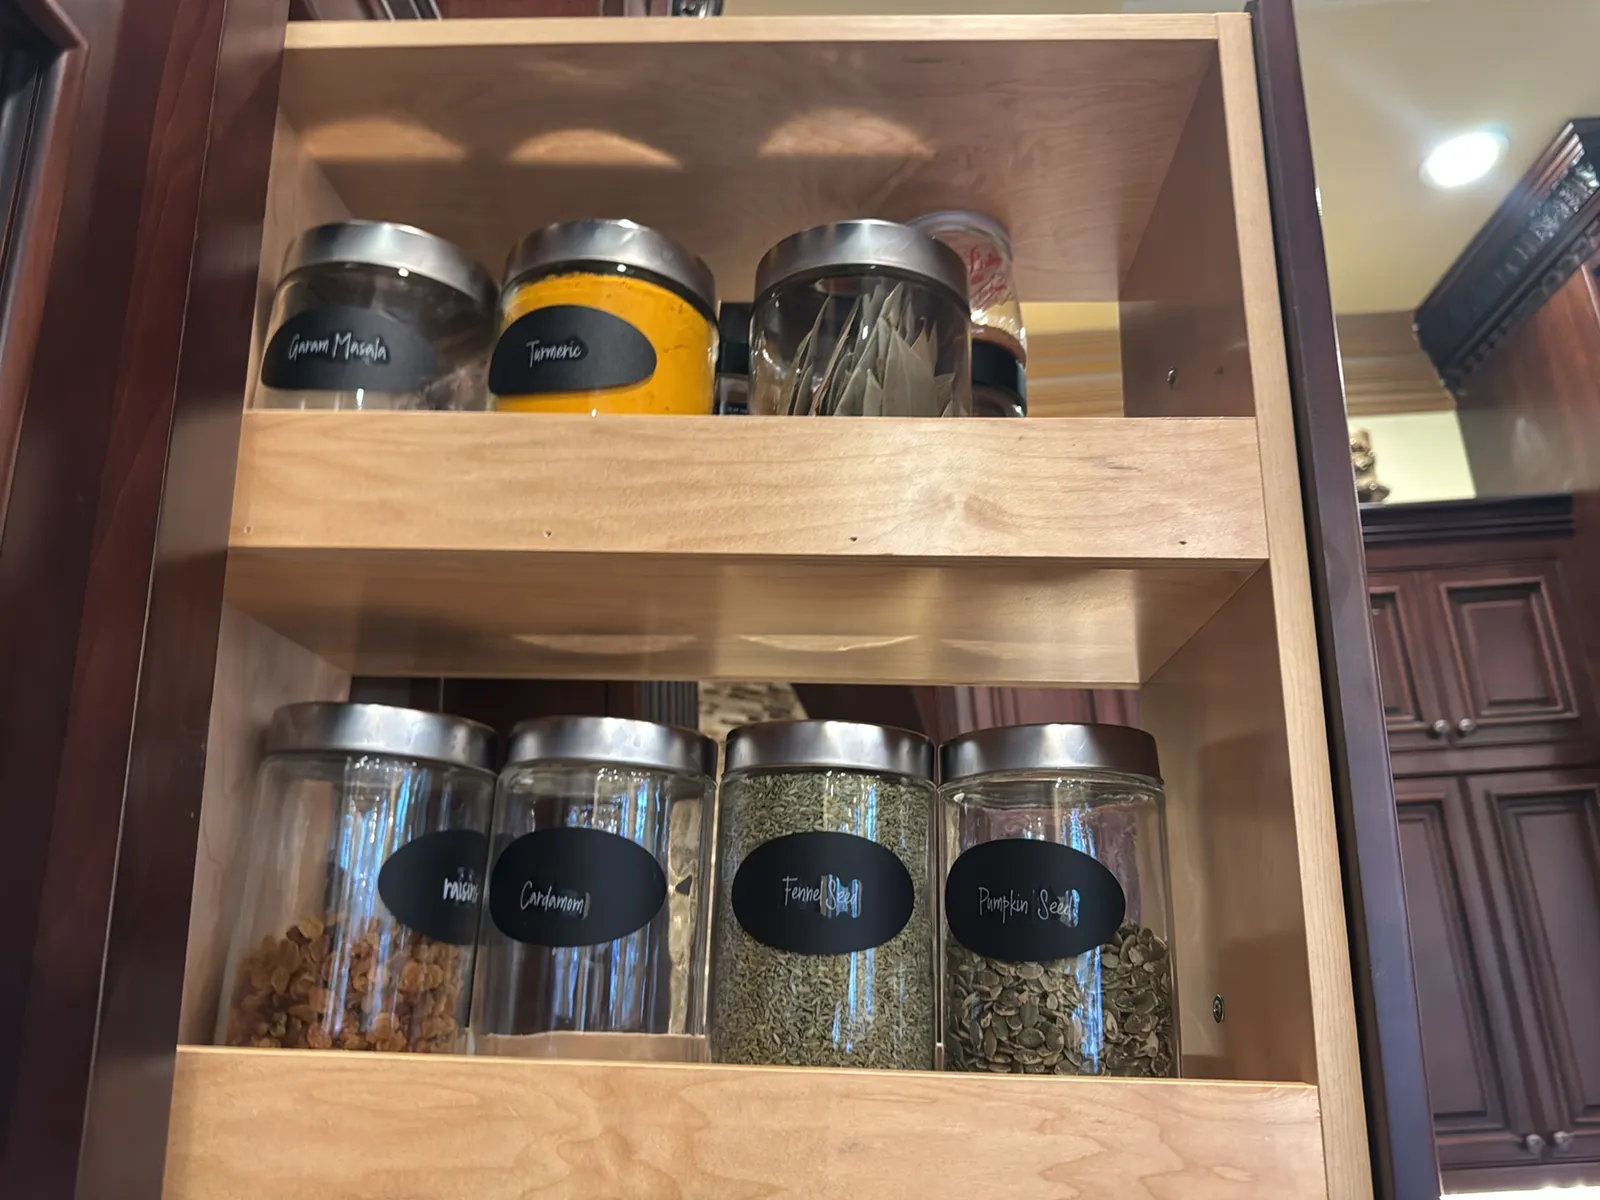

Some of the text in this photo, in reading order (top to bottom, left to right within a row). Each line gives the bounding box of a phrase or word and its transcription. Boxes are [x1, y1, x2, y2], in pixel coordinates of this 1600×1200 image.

[288, 331, 388, 362] Garam Masala
[526, 339, 582, 368] Turmeric
[520, 880, 585, 915] Cardamom
[782, 875, 859, 911] Fennel Seed
[978, 886, 1074, 924] Pumpkin Seed
